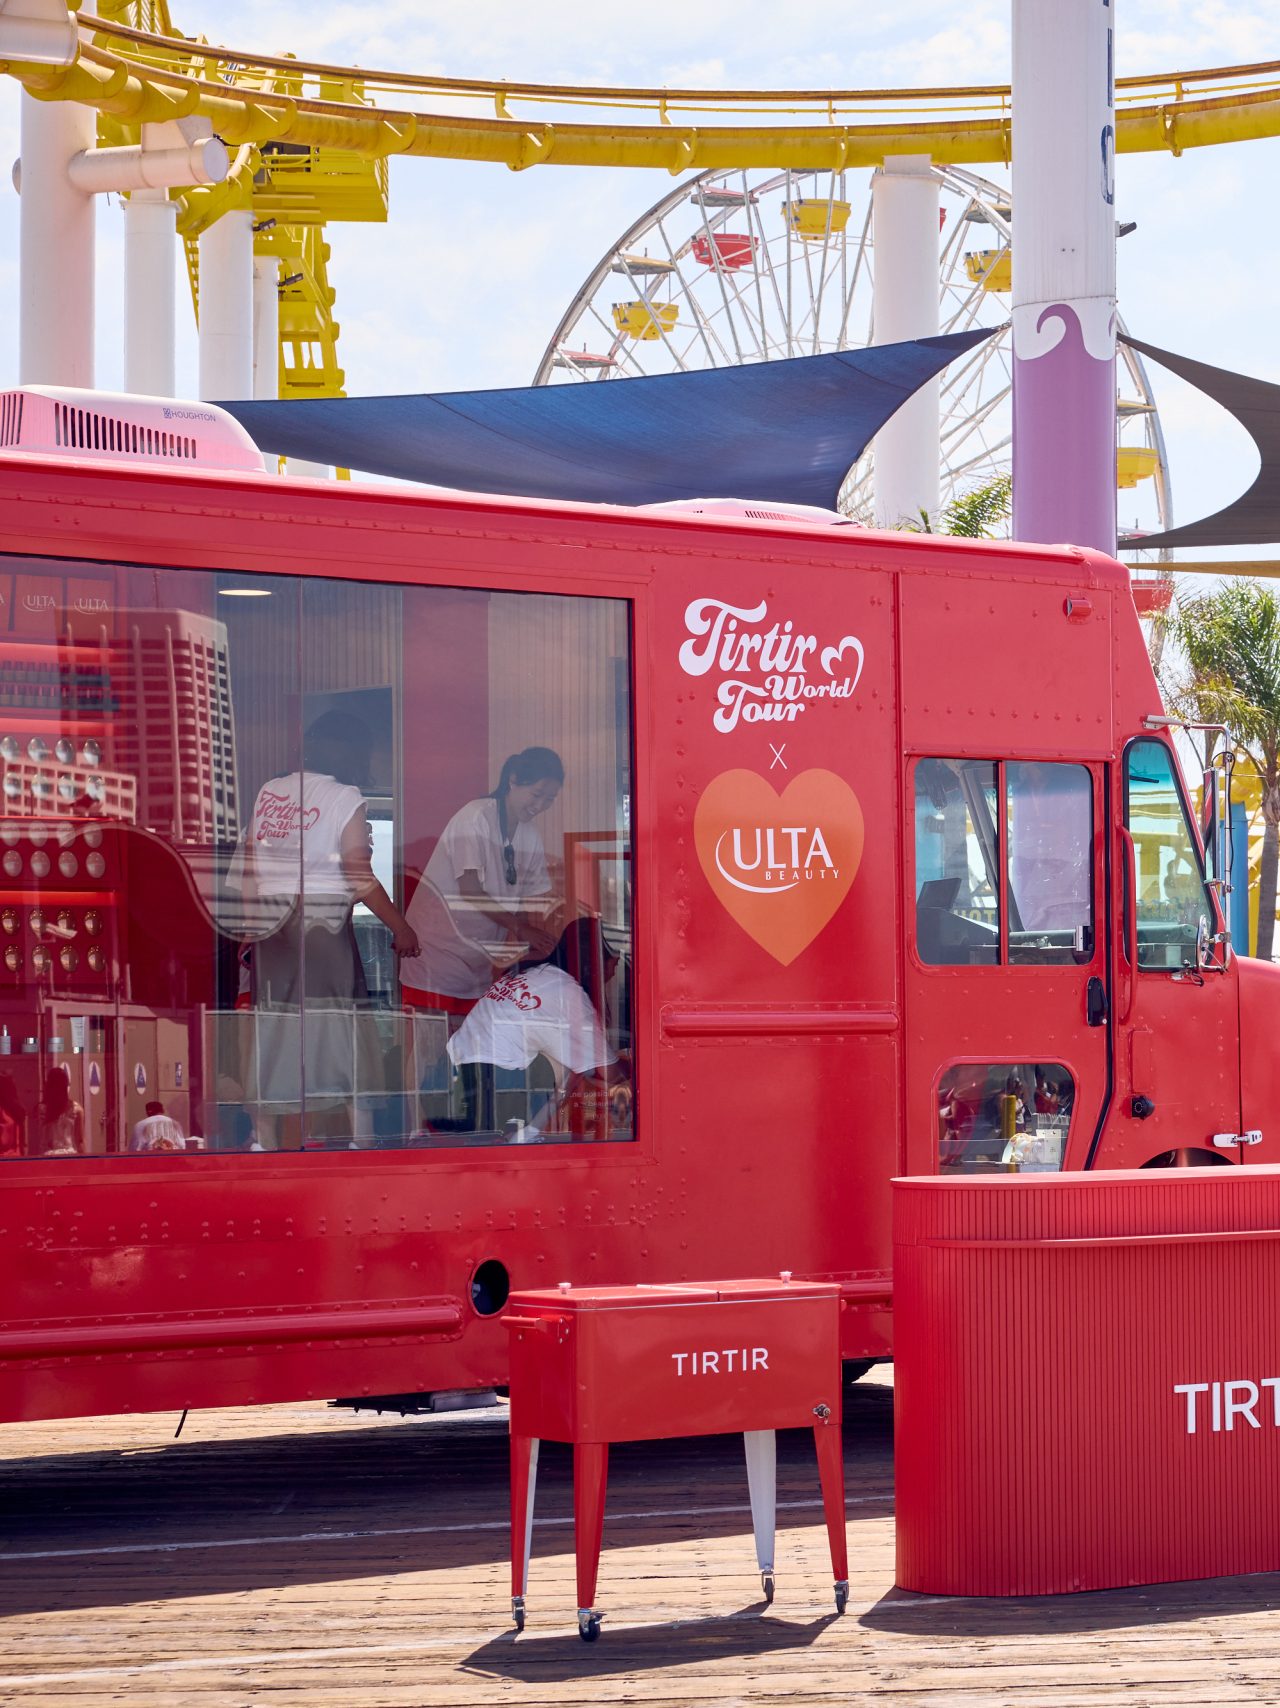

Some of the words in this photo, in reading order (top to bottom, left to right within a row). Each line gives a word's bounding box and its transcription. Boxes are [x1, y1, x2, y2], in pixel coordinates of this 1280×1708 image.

[172, 410, 216, 421] HOUGHTON
[27, 594, 56, 607] ULTA
[79, 598, 108, 610] ULTA
[679, 598, 817, 676] Tirtir
[765, 675, 851, 700] World
[713, 680, 805, 733] Tour
[256, 820, 289, 840] Tour
[276, 820, 310, 831] Word
[732, 827, 834, 871] ULTA
[765, 870, 839, 881] BEAUTY
[672, 1347, 769, 1376] TIRTIR
